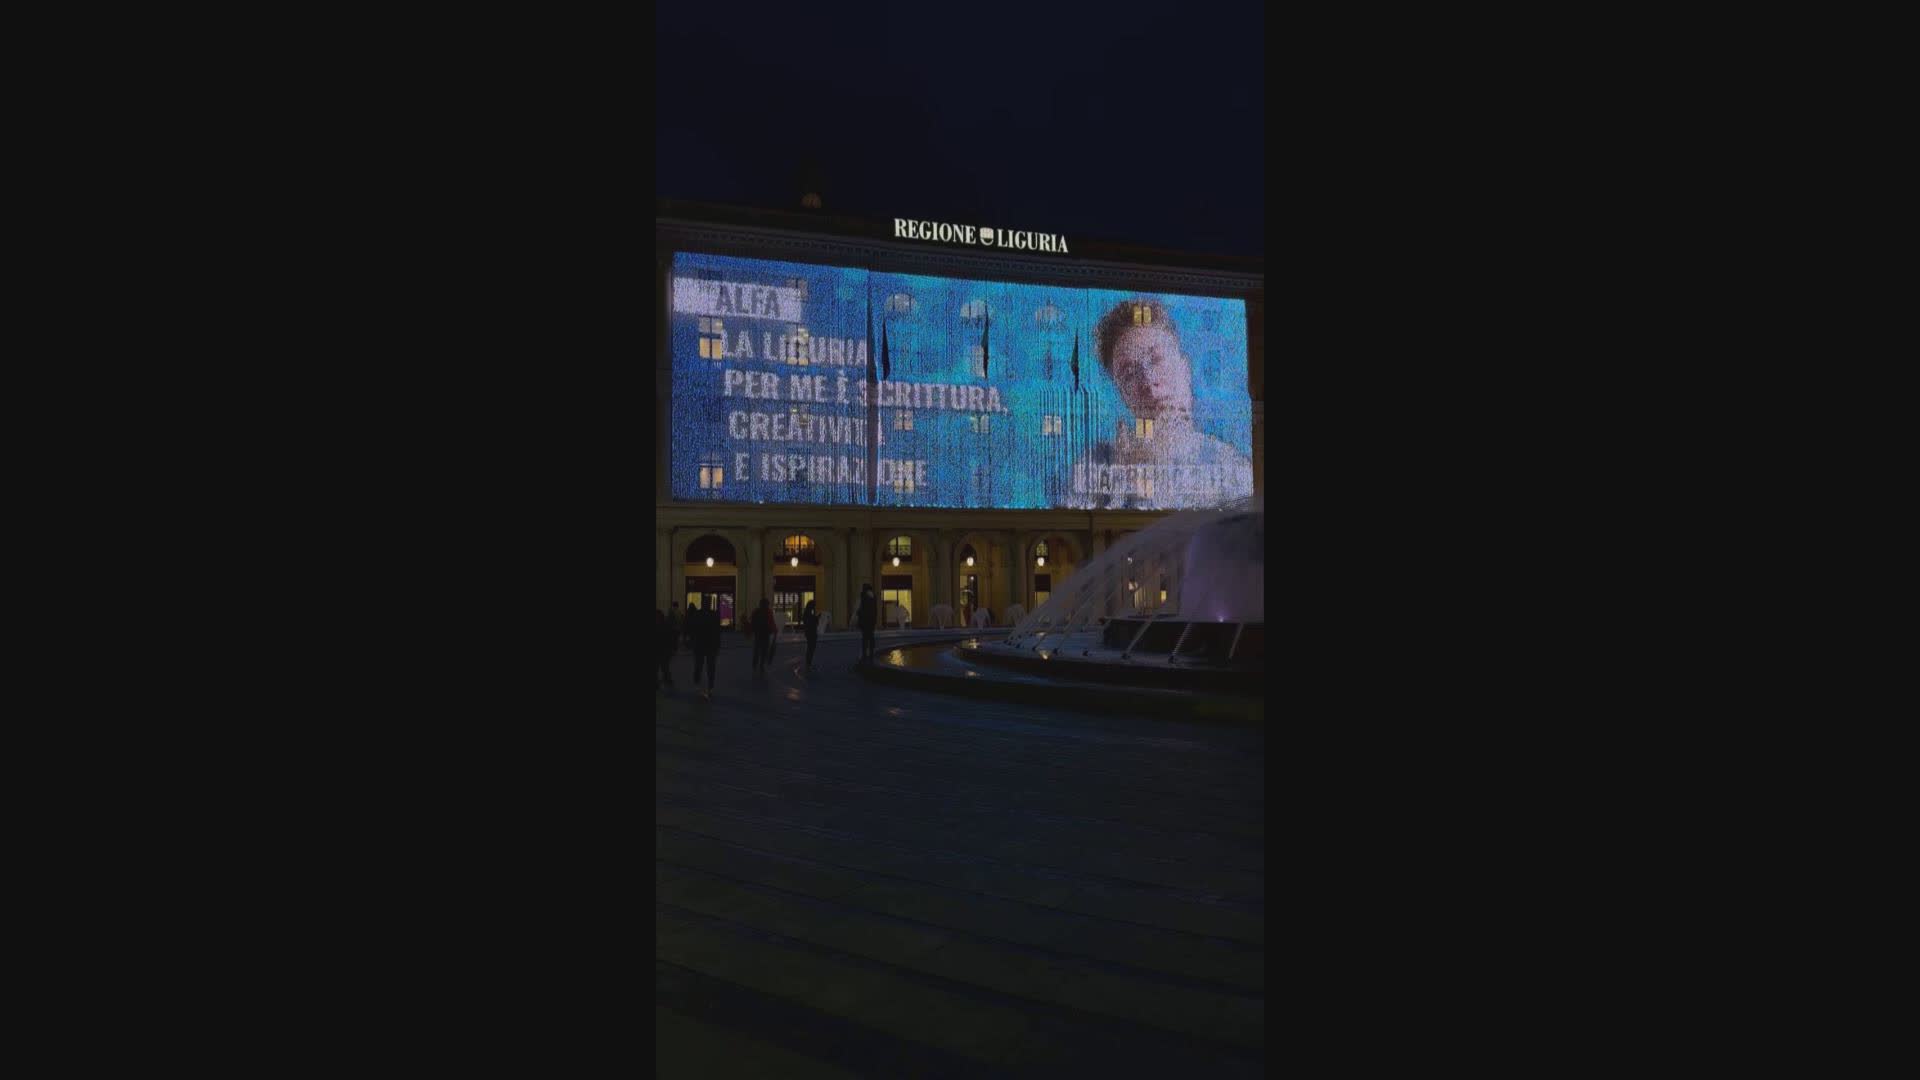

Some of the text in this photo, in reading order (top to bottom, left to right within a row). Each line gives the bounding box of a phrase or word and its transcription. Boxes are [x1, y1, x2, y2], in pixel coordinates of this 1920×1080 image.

[894, 218, 1069, 253] REGIONE LIGURIA
[715, 284, 780, 318] ALFA
[721, 329, 753, 359] LA
[724, 369, 780, 400] PER
[790, 374, 826, 402] ME
[735, 452, 750, 482] E
